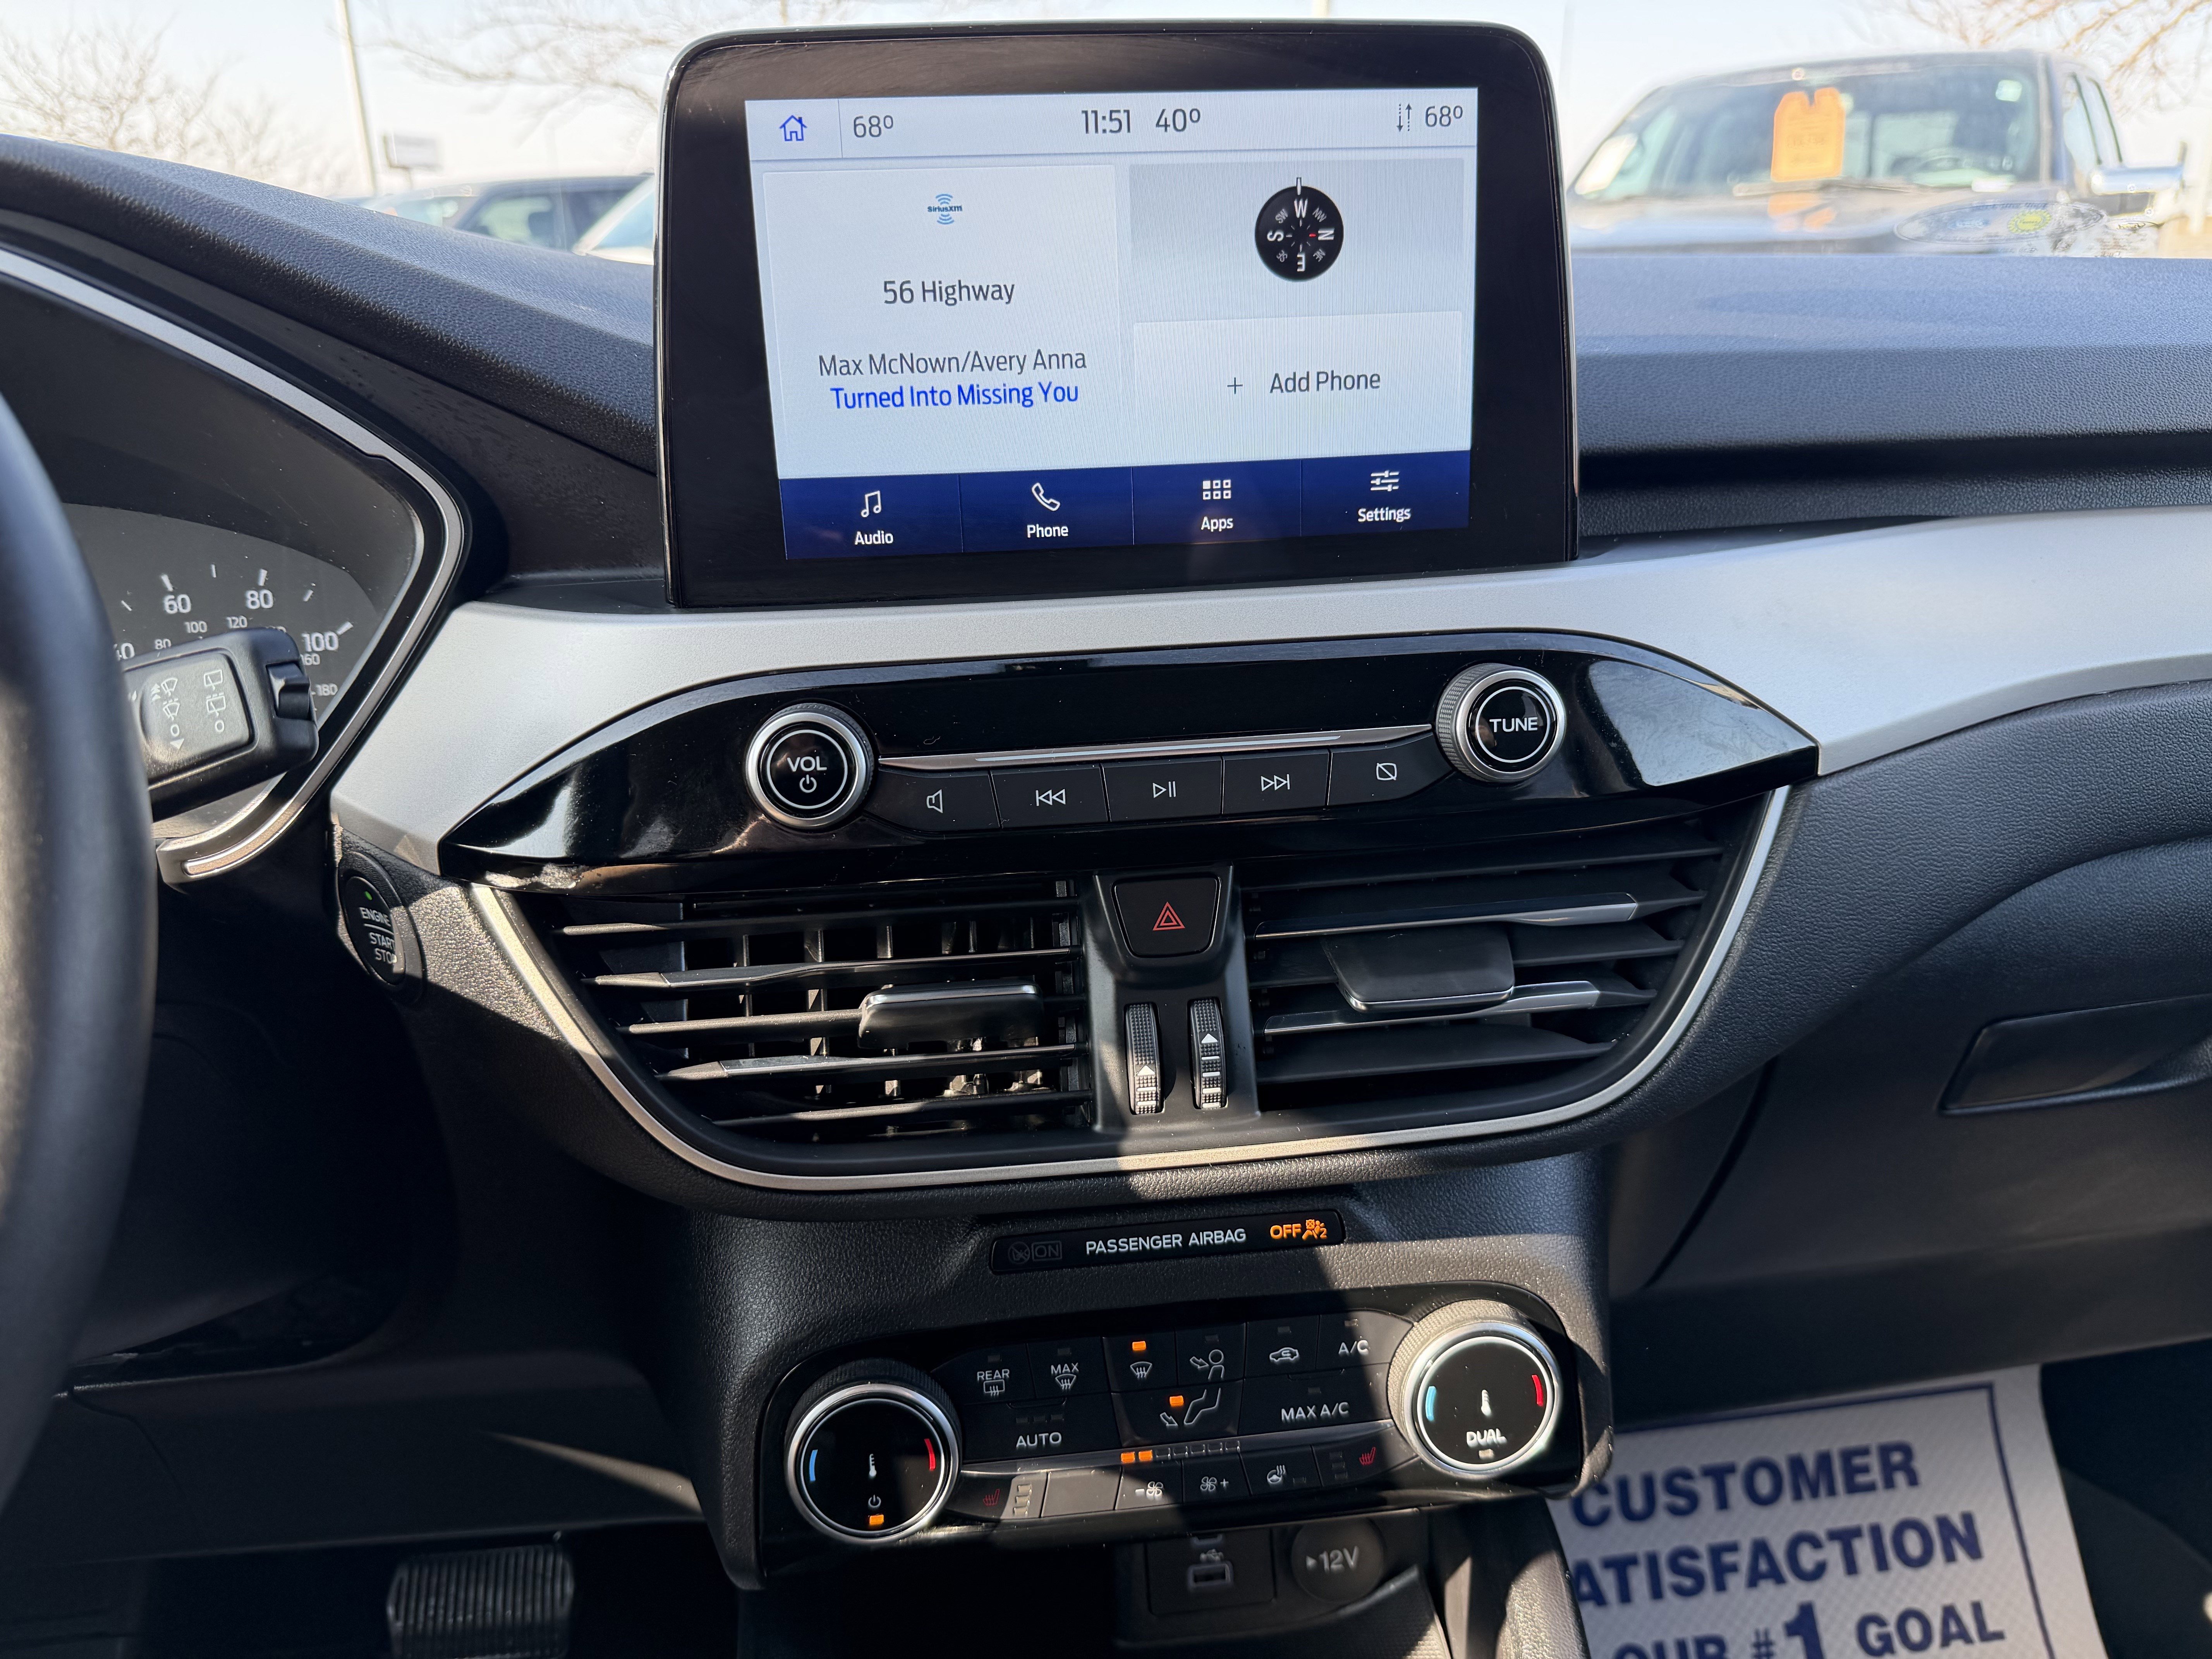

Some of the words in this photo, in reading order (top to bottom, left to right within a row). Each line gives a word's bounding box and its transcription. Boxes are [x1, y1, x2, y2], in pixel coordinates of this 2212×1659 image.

[1081, 109, 1131, 134] 11:51
[1294, 198, 1308, 218] W
[1267, 230, 1284, 242] S
[1318, 228, 1334, 240] N
[1297, 252, 1305, 271] E
[884, 280, 914, 304] 56
[922, 279, 1015, 306] Highway
[819, 354, 864, 376] Max
[869, 350, 1027, 375] McNown/Avery
[1032, 349, 1087, 370] Anna
[1269, 371, 1310, 393] Add
[1316, 370, 1381, 392] Phone
[830, 385, 904, 409] Turned
[910, 385, 952, 407] Into
[957, 383, 1034, 408] Missing
[1038, 381, 1078, 402] You
[1201, 516, 1233, 532] Apps
[1358, 507, 1411, 522] Settings
[855, 530, 893, 545] Audio
[1027, 524, 1069, 538] Phone
[163, 594, 191, 614] 60
[246, 589, 273, 610] 80
[184, 621, 208, 633] 100
[226, 615, 247, 629] 120
[302, 632, 339, 652] 100
[316, 683, 338, 696] 180
[1489, 717, 1538, 733] TUNE
[787, 756, 827, 774] VOL
[359, 907, 392, 927] ENGINE
[369, 932, 395, 949] START
[1086, 1234, 1182, 1254] PASSENGER
[1188, 1228, 1246, 1246] AIRBAG
[1270, 1223, 1302, 1239] OFF
[1035, 1244, 1059, 1257] ON
[1338, 1340, 1369, 1355] A/C
[977, 1369, 1010, 1381] REAR
[1051, 1362, 1079, 1374] MAX
[1281, 1405, 1316, 1421] MAX
[1320, 1402, 1348, 1417] A/C
[1016, 1432, 1062, 1448] AUTO
[1466, 1428, 1507, 1447] DUAL
[1572, 1440, 1920, 1527] CUSTOMER
[1320, 1546, 1359, 1571] 12V
[1572, 1510, 1982, 1607] ATISFACTION
[1855, 1601, 2005, 1658] GOAL
